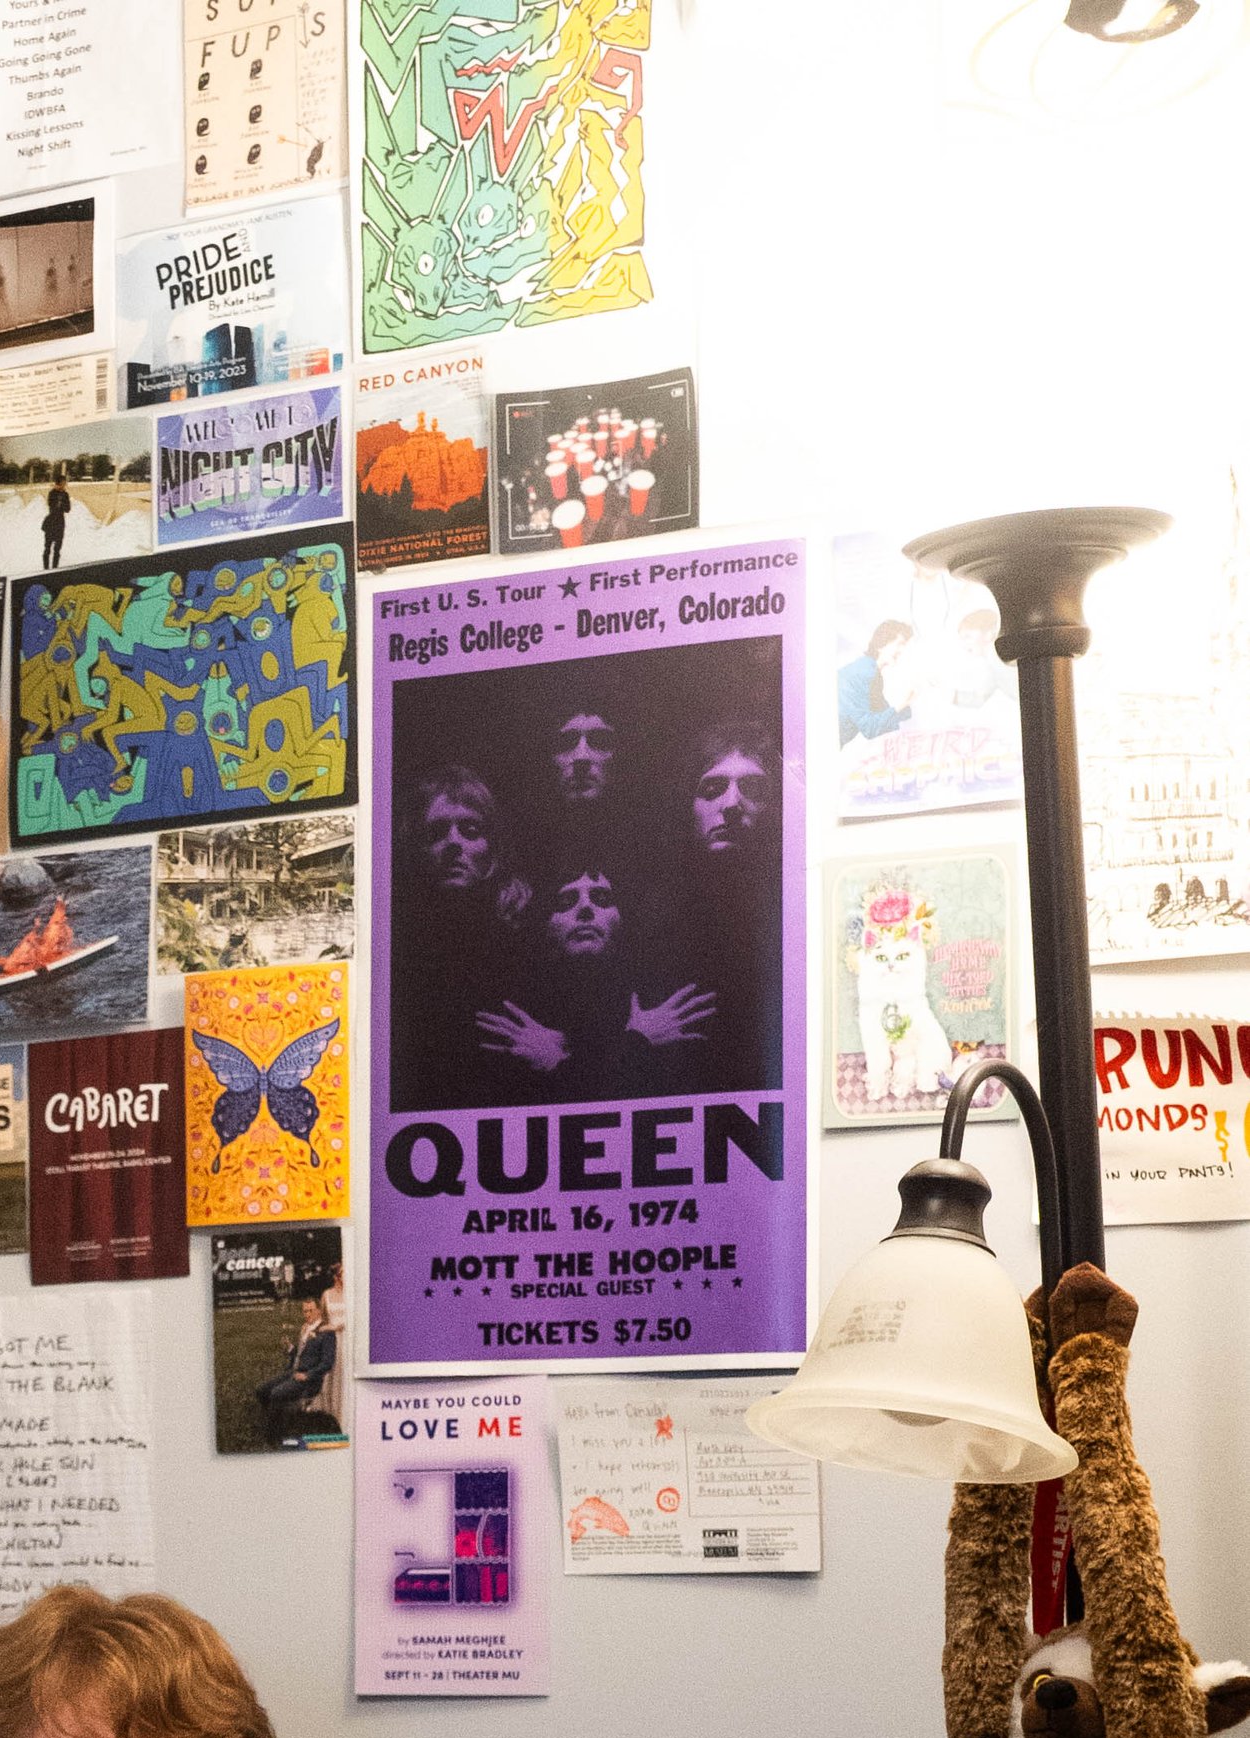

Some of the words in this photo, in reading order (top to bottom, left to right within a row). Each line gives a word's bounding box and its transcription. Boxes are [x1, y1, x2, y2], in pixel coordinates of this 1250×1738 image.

[2, 16, 42, 30] Partner
[45, 14, 54, 23] in
[57, 7, 87, 21] Crime
[13, 35, 45, 47] Home
[48, 28, 77, 42] Again
[31, 50, 63, 64] Going
[64, 43, 92, 57] Gone
[9, 70, 50, 85] Thumbs
[53, 64, 82, 78] Again
[26, 87, 65, 101] Brando
[6, 125, 42, 142] Kissing
[43, 120, 84, 136] Lessons
[17, 144, 44, 158] Night
[47, 138, 71, 153] Shift
[156, 232, 242, 291] PRIDE
[168, 254, 276, 310] PREJUDICE
[223, 294, 244, 307] Kate
[137, 373, 188, 393] November
[219, 361, 247, 379] 2023
[358, 372, 396, 394] RED
[402, 356, 485, 385] CANYON
[160, 446, 255, 523] NIGHT
[260, 415, 339, 500] CITY
[359, 548, 387, 558] DIXIE
[389, 539, 444, 553] NATIONAL
[446, 531, 489, 544] FOREST
[380, 597, 432, 620] First
[437, 593, 460, 612] U.
[465, 588, 488, 608] S.
[496, 583, 548, 605] Tour
[588, 567, 642, 592] First
[649, 550, 800, 585] Performance
[388, 626, 449, 666] Regis
[459, 601, 545, 656] College
[575, 604, 667, 641] Denver,
[677, 585, 786, 626] Colorado
[44, 1083, 170, 1134] CABARET
[384, 1101, 785, 1199] QUEEN
[1132, 1162, 1167, 1182] YOUR
[461, 1206, 557, 1235] APRIL
[569, 1203, 617, 1234] 16,
[628, 1198, 699, 1228] 1974
[225, 1255, 285, 1272] cancer
[429, 1254, 520, 1281] MOTT
[534, 1251, 594, 1279] THE
[608, 1243, 738, 1276] HOOPLE
[510, 1281, 588, 1300] SPECIAL
[596, 1278, 657, 1298] GUEST
[477, 1319, 600, 1347] TICKETS
[614, 1315, 693, 1346] $7.50
[34, 1333, 72, 1356] ME
[4, 1375, 46, 1394] THE
[52, 1375, 115, 1394] BLANK
[381, 1399, 430, 1411] MAYBE
[435, 1398, 466, 1409] YOU
[471, 1395, 522, 1407] COULD
[381, 1418, 460, 1441] LOVE
[477, 1416, 523, 1438] ME
[57, 1452, 96, 1472] SUN
[50, 1496, 121, 1513] NEEDED
[412, 1636, 451, 1646] SAMAH
[381, 1650, 422, 1661] directed
[437, 1650, 469, 1660] KATIE
[471, 1649, 524, 1660] BRADLEY
[384, 1671, 410, 1682] SEPT
[451, 1670, 498, 1681] THEATER
[500, 1670, 521, 1681] MU
